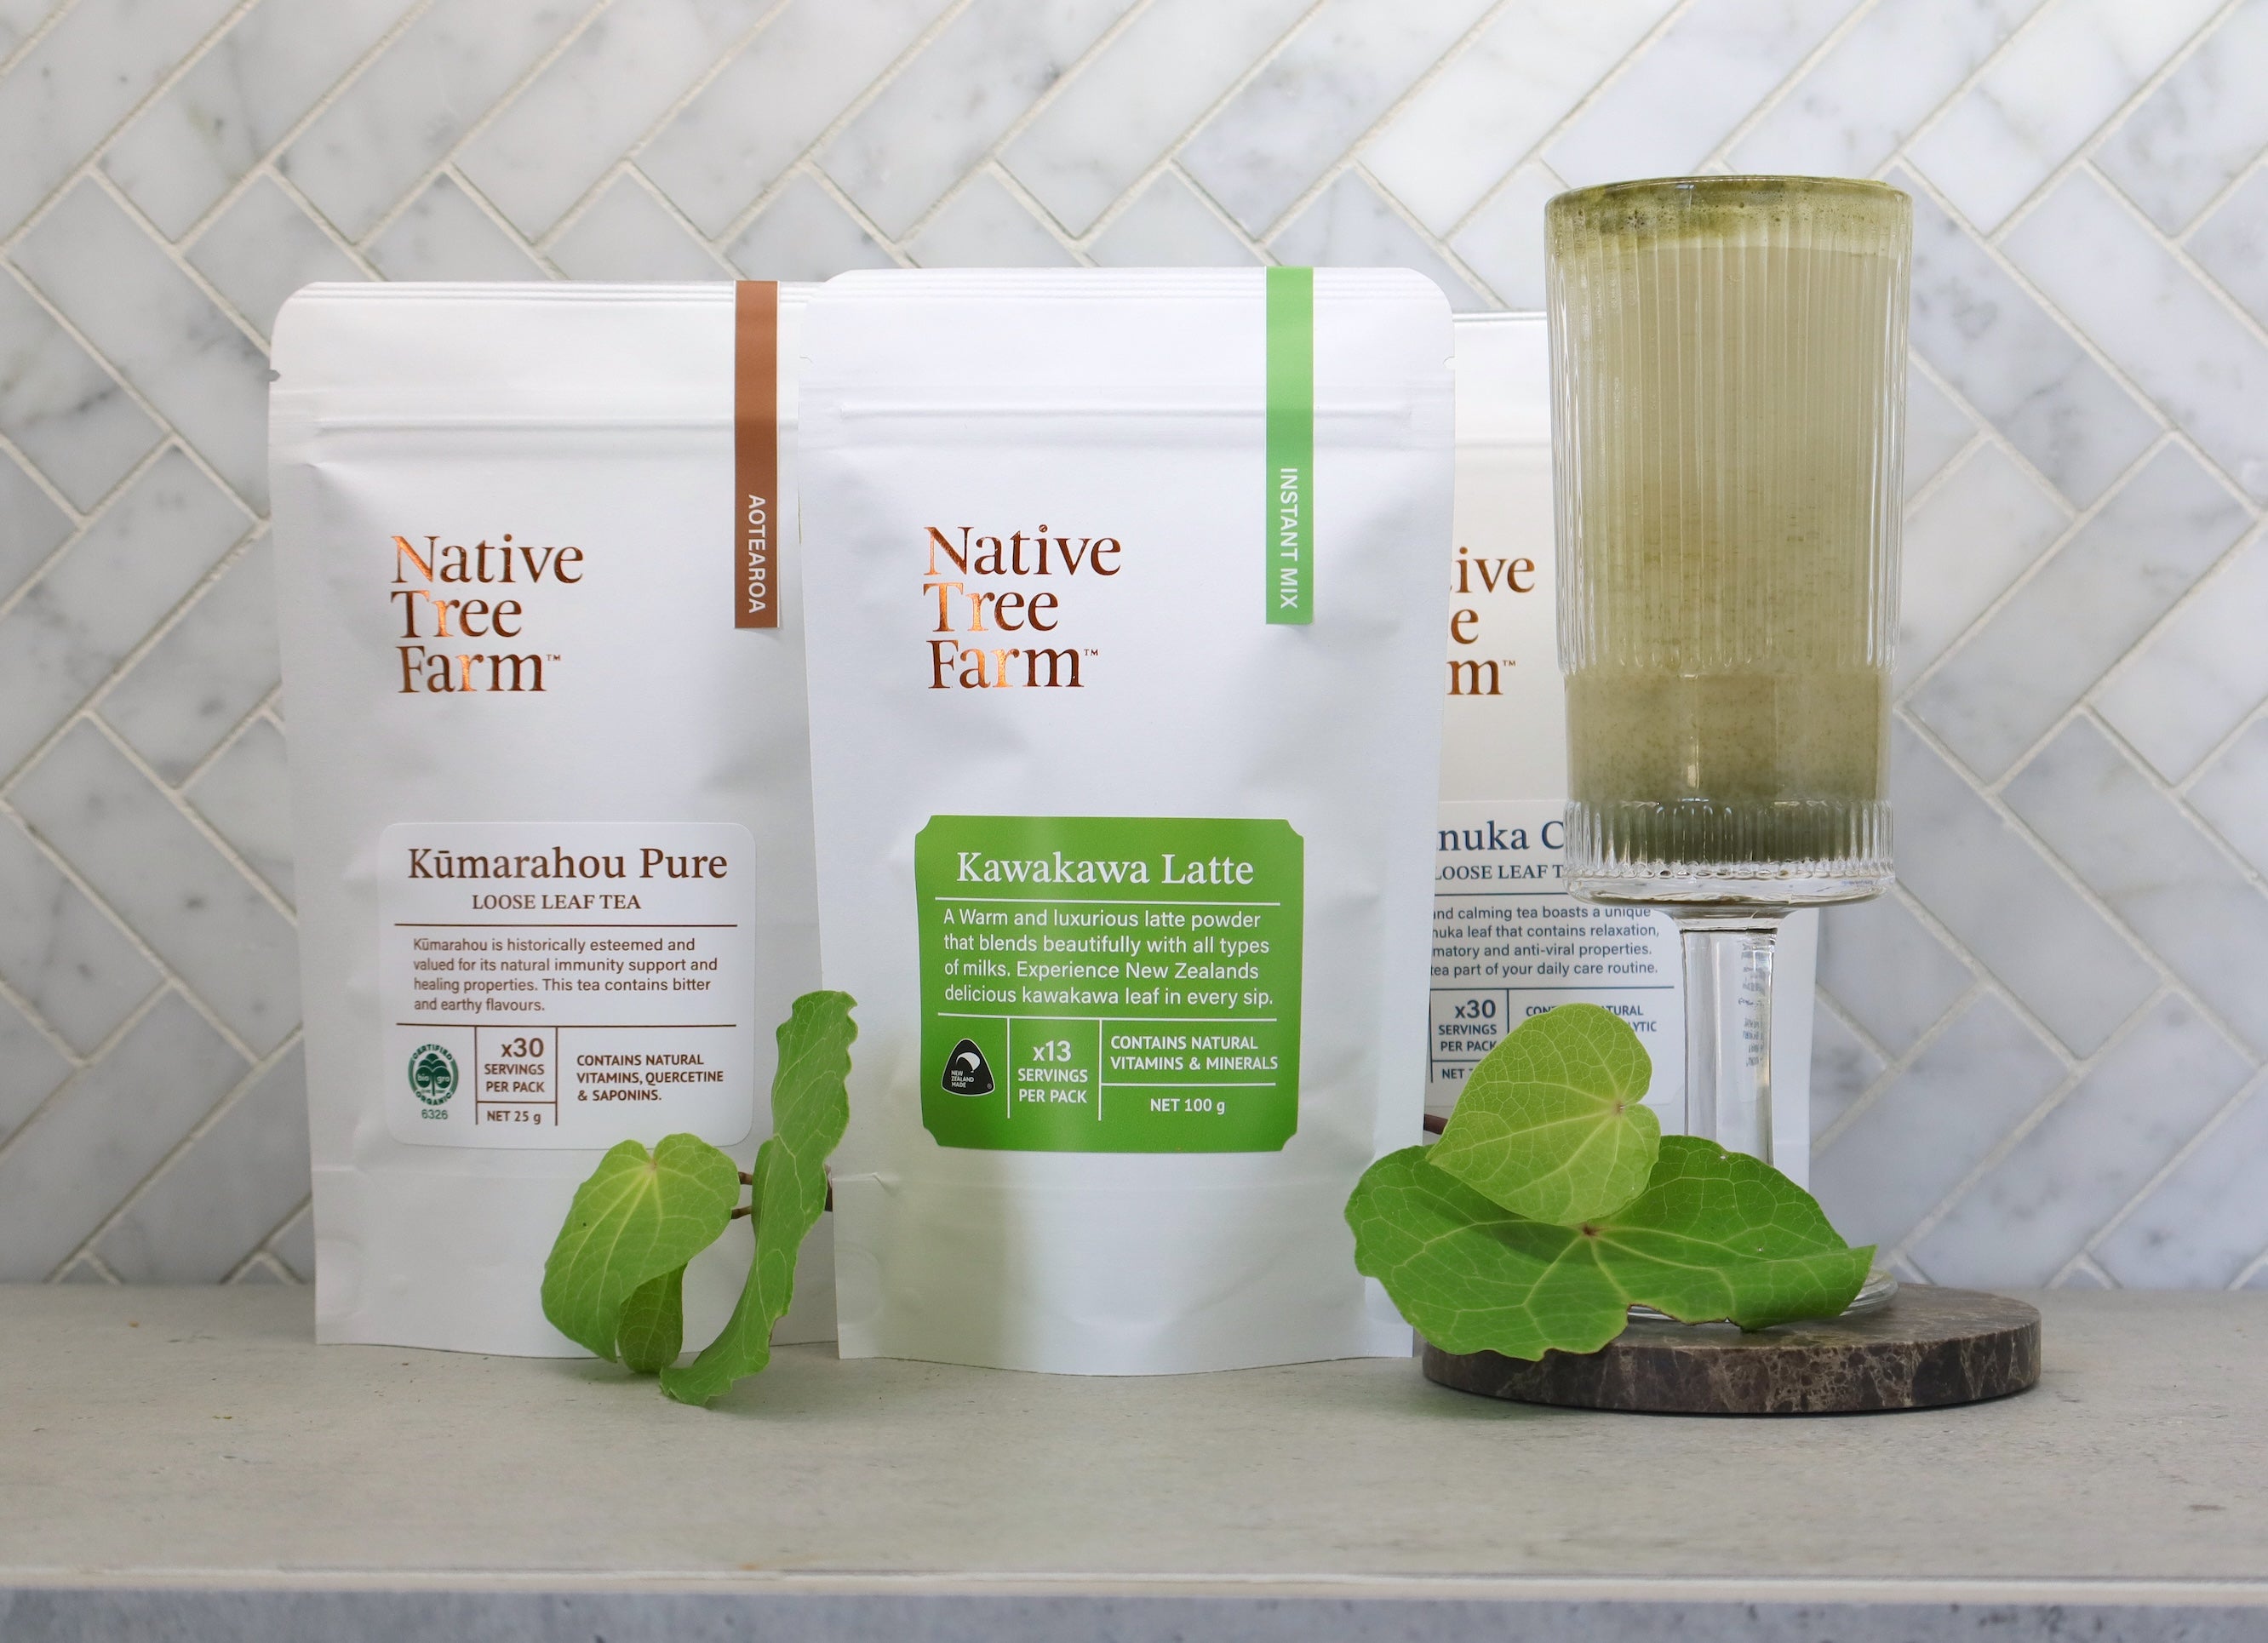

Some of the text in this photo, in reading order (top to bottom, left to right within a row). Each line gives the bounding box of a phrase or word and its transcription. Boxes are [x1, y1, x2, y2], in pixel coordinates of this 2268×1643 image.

[1280, 467, 1298, 610] INSTANT MIX
[391, 533, 584, 584] Native
[747, 494, 766, 614] AOTEAROA
[924, 524, 1121, 576] Native
[1456, 546, 1535, 594] ive
[391, 590, 523, 638] Tree
[923, 582, 1059, 633] Tree
[1438, 820, 1531, 851] nuka
[408, 845, 728, 879] Kūmarahou Pure
[956, 850, 1254, 885] Kawakawa Latte
[1498, 864, 1549, 879] LEAF
[472, 894, 642, 910] LOOSE LEAF TEA
[943, 907, 1262, 932] A Warm and luxurious latte powder
[1433, 905, 1652, 922] nd calming tea boasts a unique
[1432, 923, 1660, 939] nuka leaf that contains relaxation,
[413, 937, 696, 954] Kūmarahou is historically esteemed and
[943, 932, 1270, 958] that blends beautifully with all types
[1483, 943, 1509, 957] and
[1514, 942, 1575, 957] anti-viral
[1578, 942, 1652, 959] properties.
[413, 957, 718, 975] valued for its natural immunity support and
[944, 958, 1259, 982] of milks. Experience New Zealands
[1430, 960, 1658, 979] tea part of your daily care routine.
[414, 977, 712, 994] healing properties. This tea contains bitter
[944, 983, 1274, 1010] delicious kawakawa leaf in every sip.
[414, 997, 546, 1015] and earthy flavours.
[1454, 999, 1497, 1019] x30
[1601, 1005, 1644, 1016] TURAL
[1438, 1023, 1498, 1036] SERVINGS
[501, 1037, 545, 1058] x30
[1033, 1039, 1072, 1062] x13
[1110, 1035, 1259, 1050] CONTAINS NATURAL
[1440, 1040, 1498, 1053] PER PACK
[576, 1054, 705, 1067] CONTAINS NATURAL
[1109, 1056, 1279, 1071] VITAMINS & MINERALS
[484, 1063, 545, 1076] SERVINGS
[1017, 1068, 1089, 1084] SERVINGS
[1441, 1068, 1465, 1079] NET
[417, 1073, 450, 1085] bio gro
[485, 1080, 546, 1093] PER PACK
[576, 1070, 724, 1087] VITAMINS, QUERCETINE
[415, 1091, 451, 1105] ORGANIC
[577, 1089, 662, 1102] & SAPONINS.
[1018, 1088, 1088, 1104] PER PACK
[421, 1108, 449, 1120] 6326
[1150, 1097, 1226, 1116] NET 100 g
[486, 1110, 541, 1125] NET 25 g
